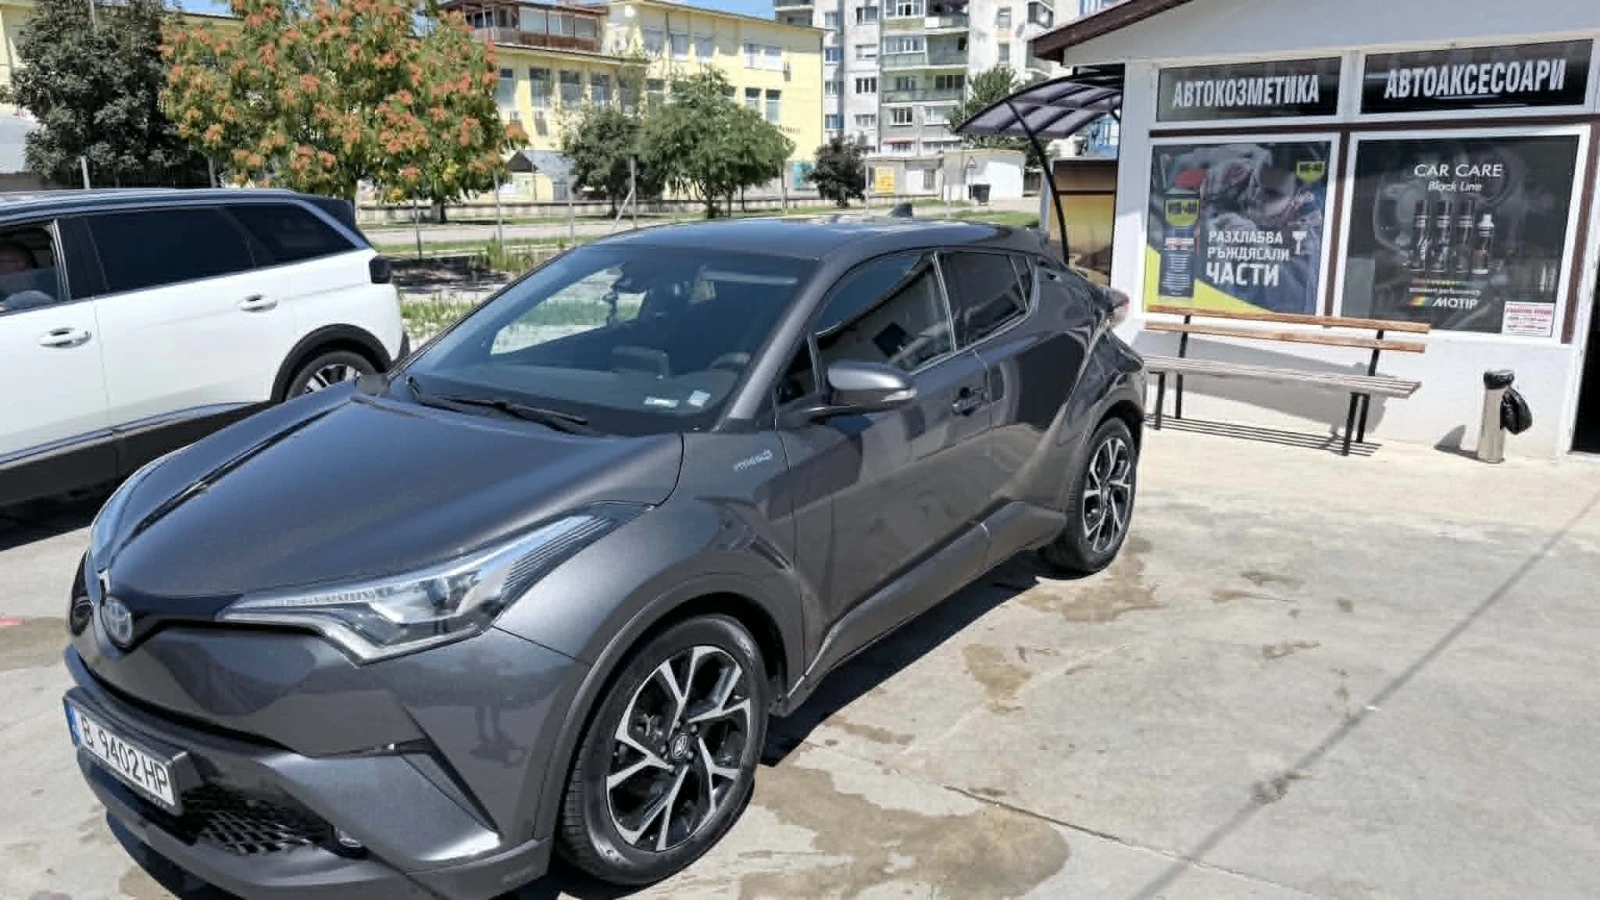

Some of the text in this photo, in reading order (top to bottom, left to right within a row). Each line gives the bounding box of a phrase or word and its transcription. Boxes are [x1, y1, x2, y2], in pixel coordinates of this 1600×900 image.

[1384, 58, 1567, 99] АВТОАКСЕСОАРИ
[1173, 74, 1319, 108] АВТОКОЗМЕТИКА
[1413, 163, 1503, 177] CAR CARE
[1460, 181, 1482, 192] Line
[1208, 230, 1284, 244] РАЗХЛАБВА
[1206, 246, 1290, 261] РЪЖДЯСАЛИ
[1205, 262, 1280, 287] ЧАСТИ
[1432, 297, 1478, 310] MOTIP
